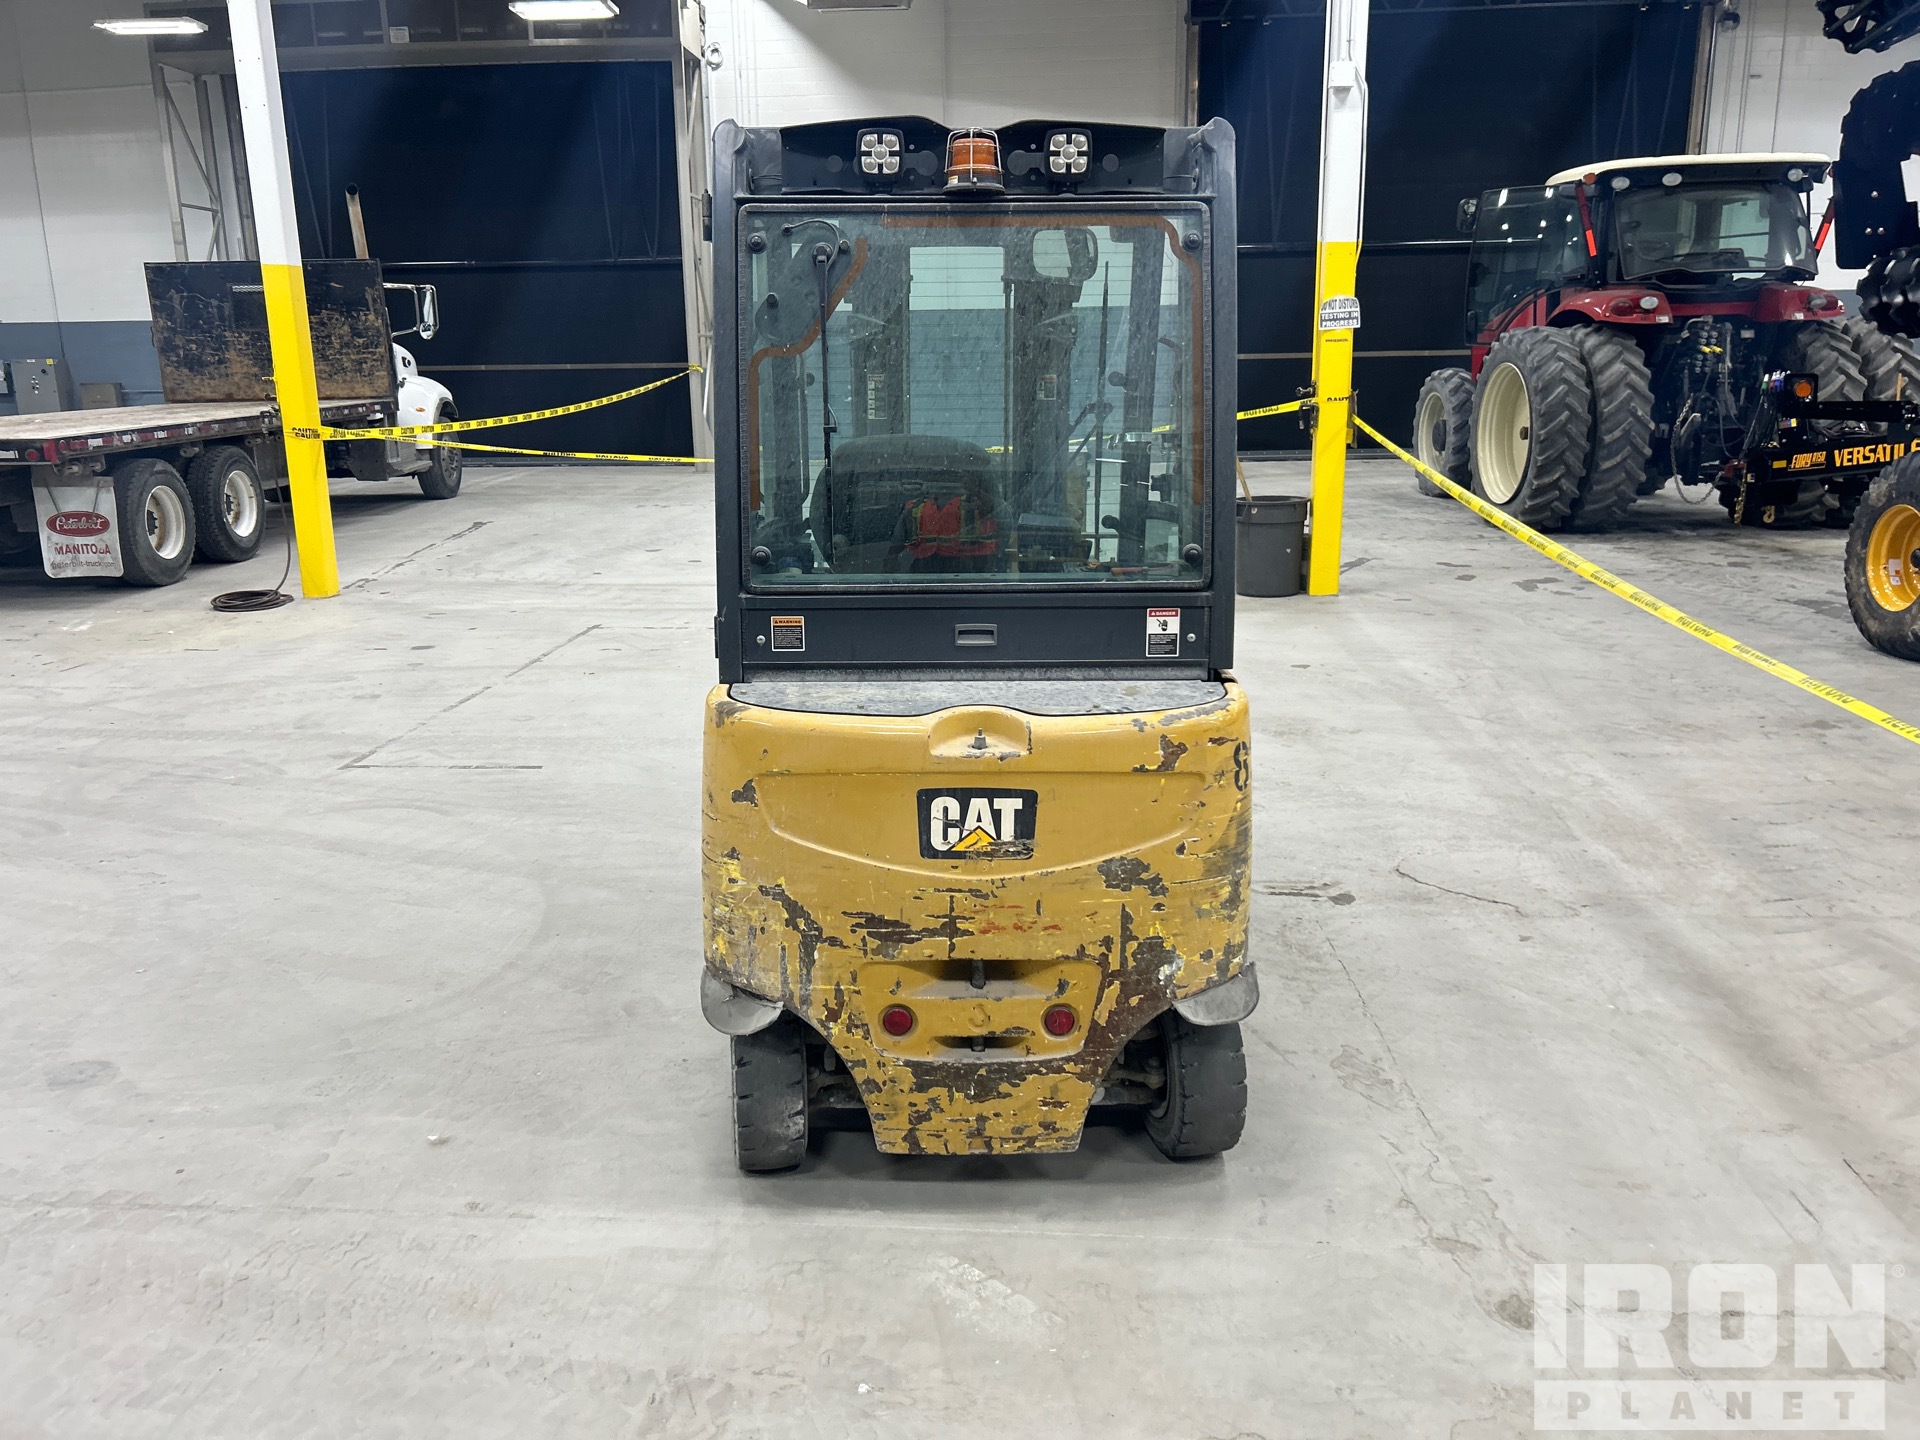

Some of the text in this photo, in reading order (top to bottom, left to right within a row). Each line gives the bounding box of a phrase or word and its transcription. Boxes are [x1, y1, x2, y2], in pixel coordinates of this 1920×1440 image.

[1322, 320, 1357, 328] PROGRESS
[1791, 453, 1813, 468] FURY
[56, 516, 105, 530] Peterbilt
[931, 796, 1023, 851] CAT
